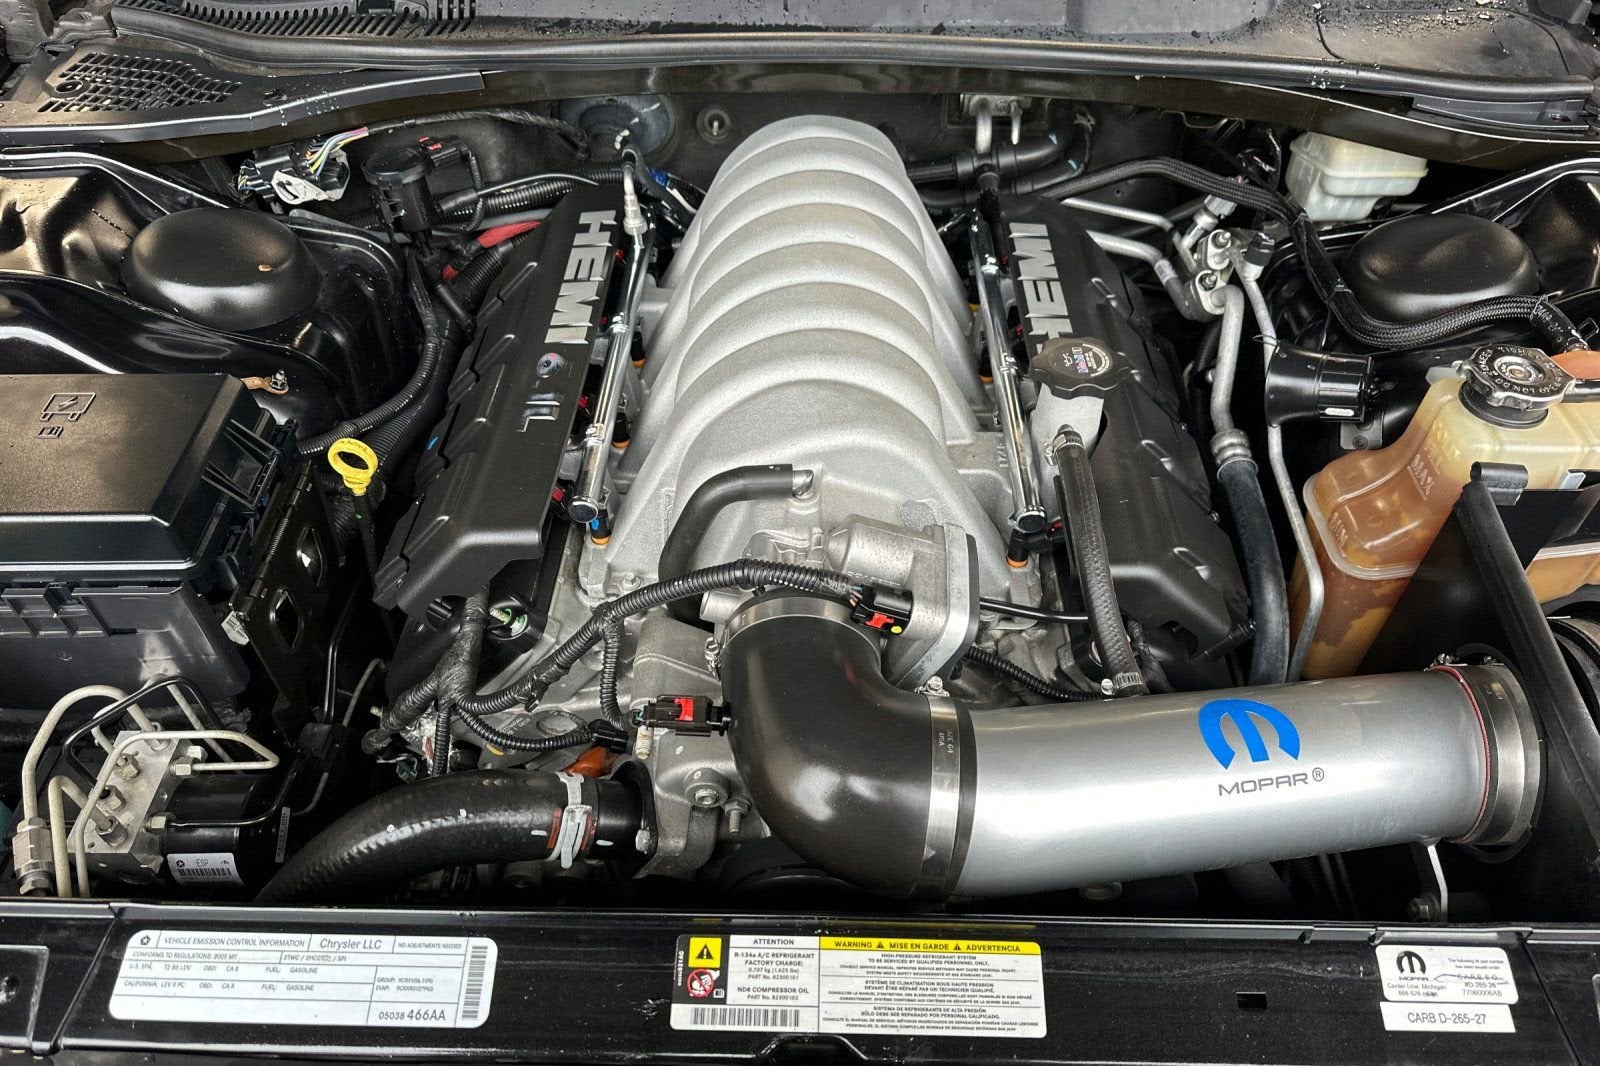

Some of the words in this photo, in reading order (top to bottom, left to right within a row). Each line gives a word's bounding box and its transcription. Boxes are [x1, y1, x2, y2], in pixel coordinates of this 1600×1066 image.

[544, 210, 617, 344] HEMI
[164, 937, 191, 945] VEHICLE
[192, 938, 224, 946] EMISSION
[226, 938, 257, 946] CONTROL
[259, 939, 305, 947] INFORMATION
[320, 937, 361, 952] Chrysler
[363, 939, 382, 950] LLC
[753, 938, 794, 946] ATTENTION
[966, 944, 1020, 952] ADVERTENCIA
[379, 1011, 405, 1020] 05038
[407, 1009, 446, 1021] 466AA
[1407, 1012, 1436, 1024] CARB
[1439, 1013, 1486, 1024] D-265-27
